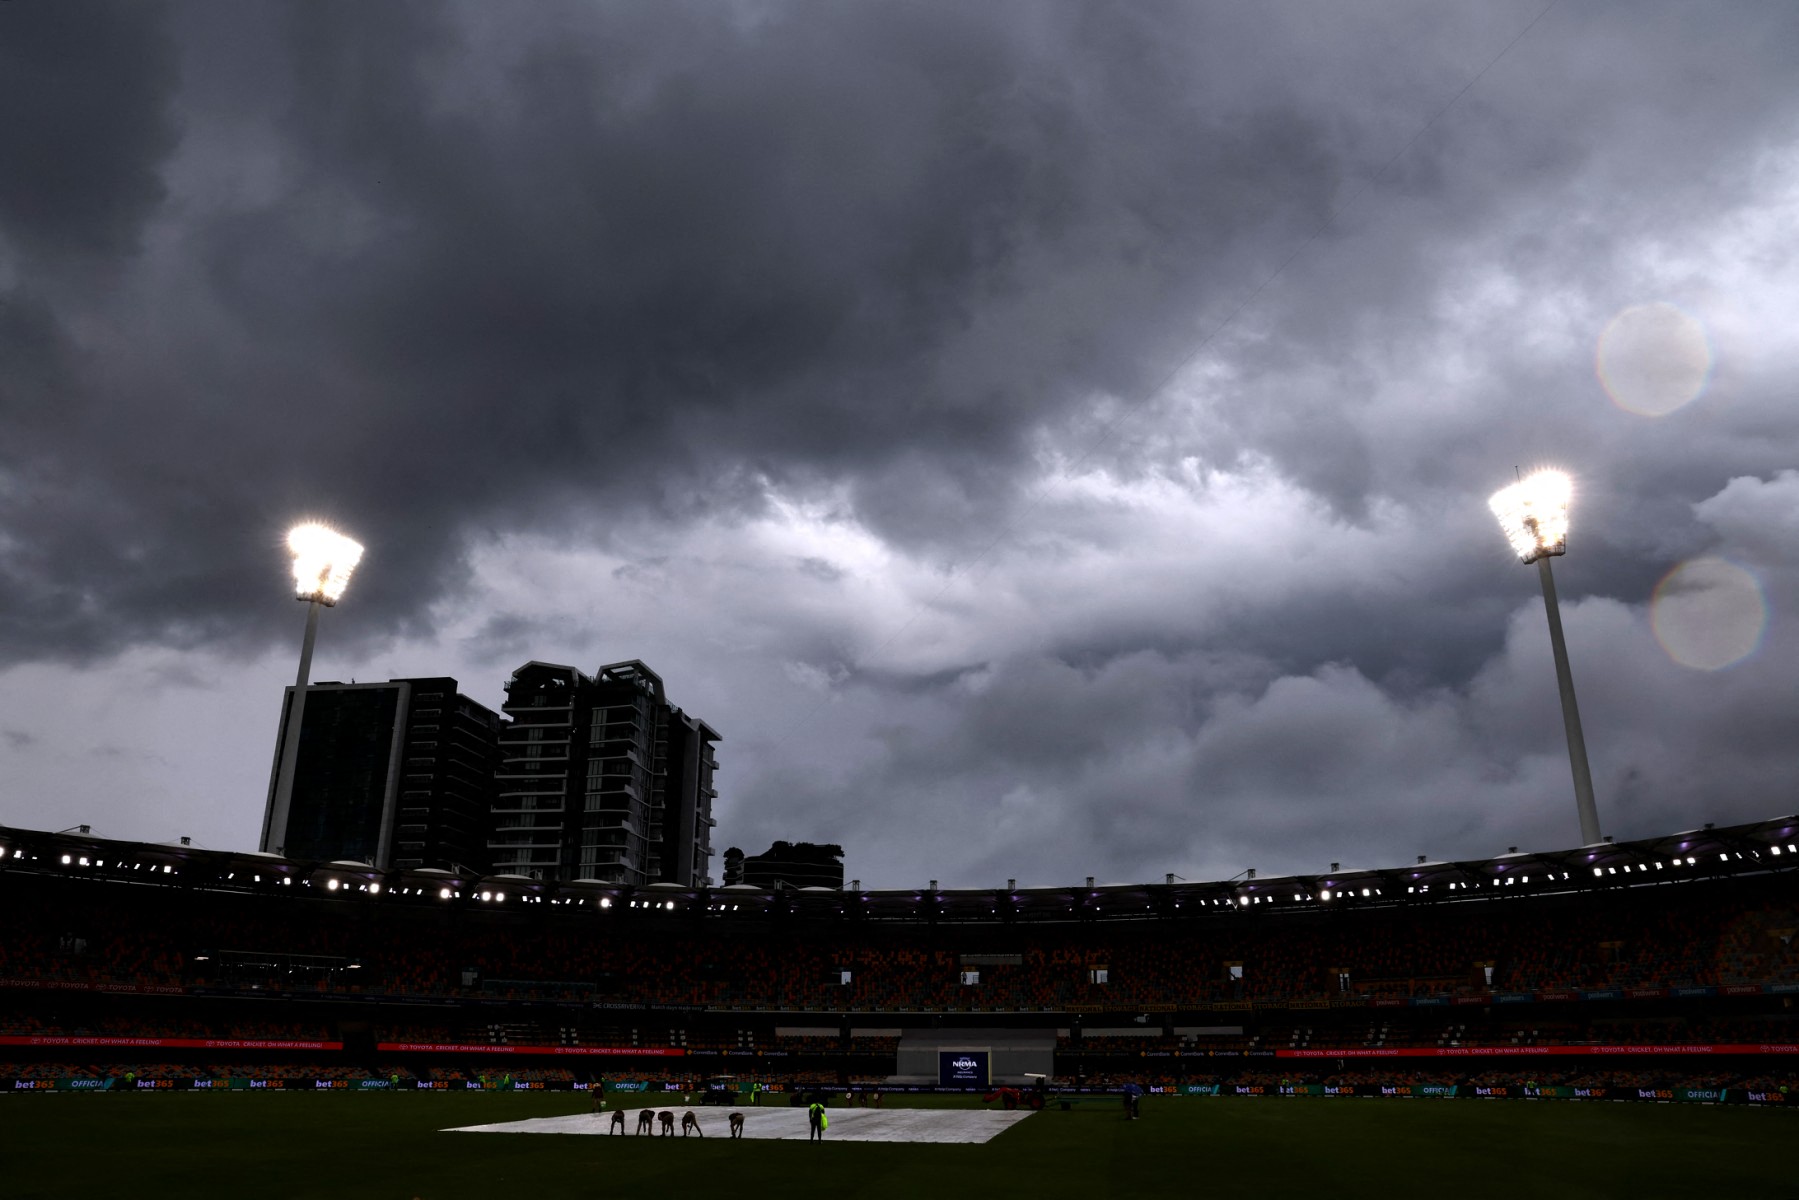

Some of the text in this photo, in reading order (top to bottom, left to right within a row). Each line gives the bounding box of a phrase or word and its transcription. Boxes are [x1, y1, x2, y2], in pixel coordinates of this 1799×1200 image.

[15, 1080, 54, 1089] bet365
[250, 1080, 284, 1088] bet365
[1639, 1089, 1673, 1098] bet365
